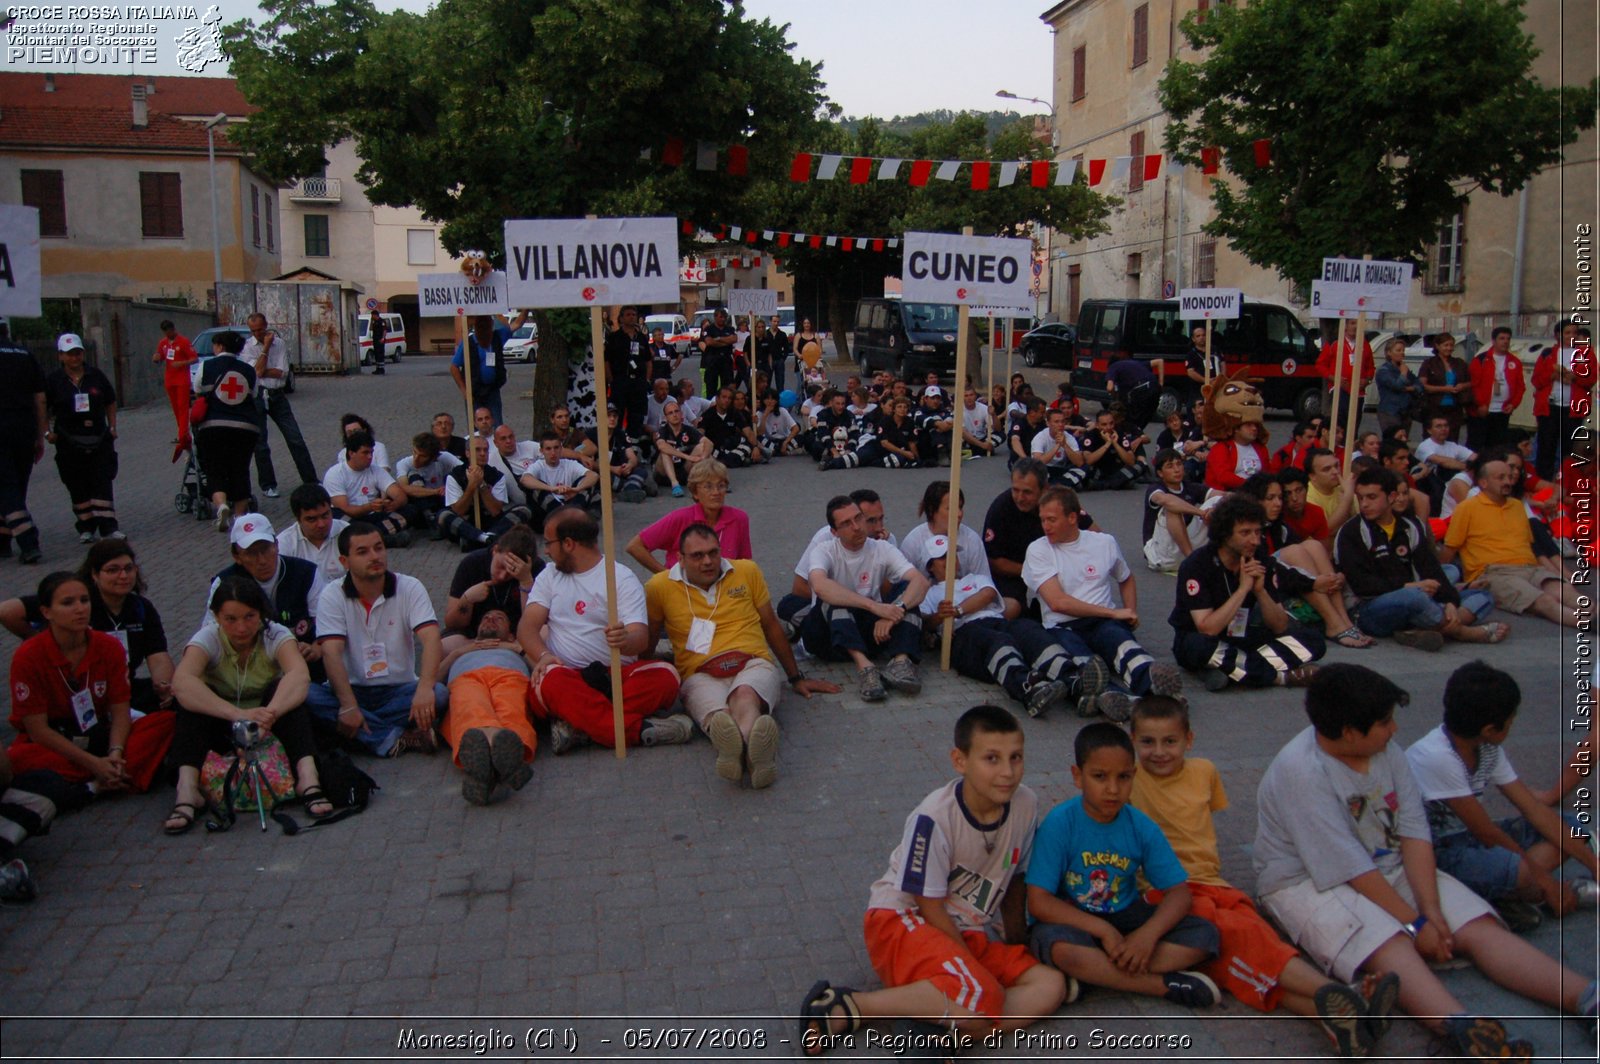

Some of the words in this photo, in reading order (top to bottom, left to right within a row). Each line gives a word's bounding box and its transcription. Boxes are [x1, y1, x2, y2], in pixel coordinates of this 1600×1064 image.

[513, 243, 662, 281] VILLANOVA
[909, 250, 1018, 284] CUNEO
[1324, 262, 1360, 283] EMILIA
[1365, 265, 1396, 285] ROMAGNA
[1397, 267, 1403, 285] 2
[424, 287, 452, 305] BASSA
[454, 287, 462, 304] V.
[463, 286, 497, 304] SCRIVIA
[1182, 296, 1234, 310] MONDOVI'
[911, 832, 926, 873] ITALY
